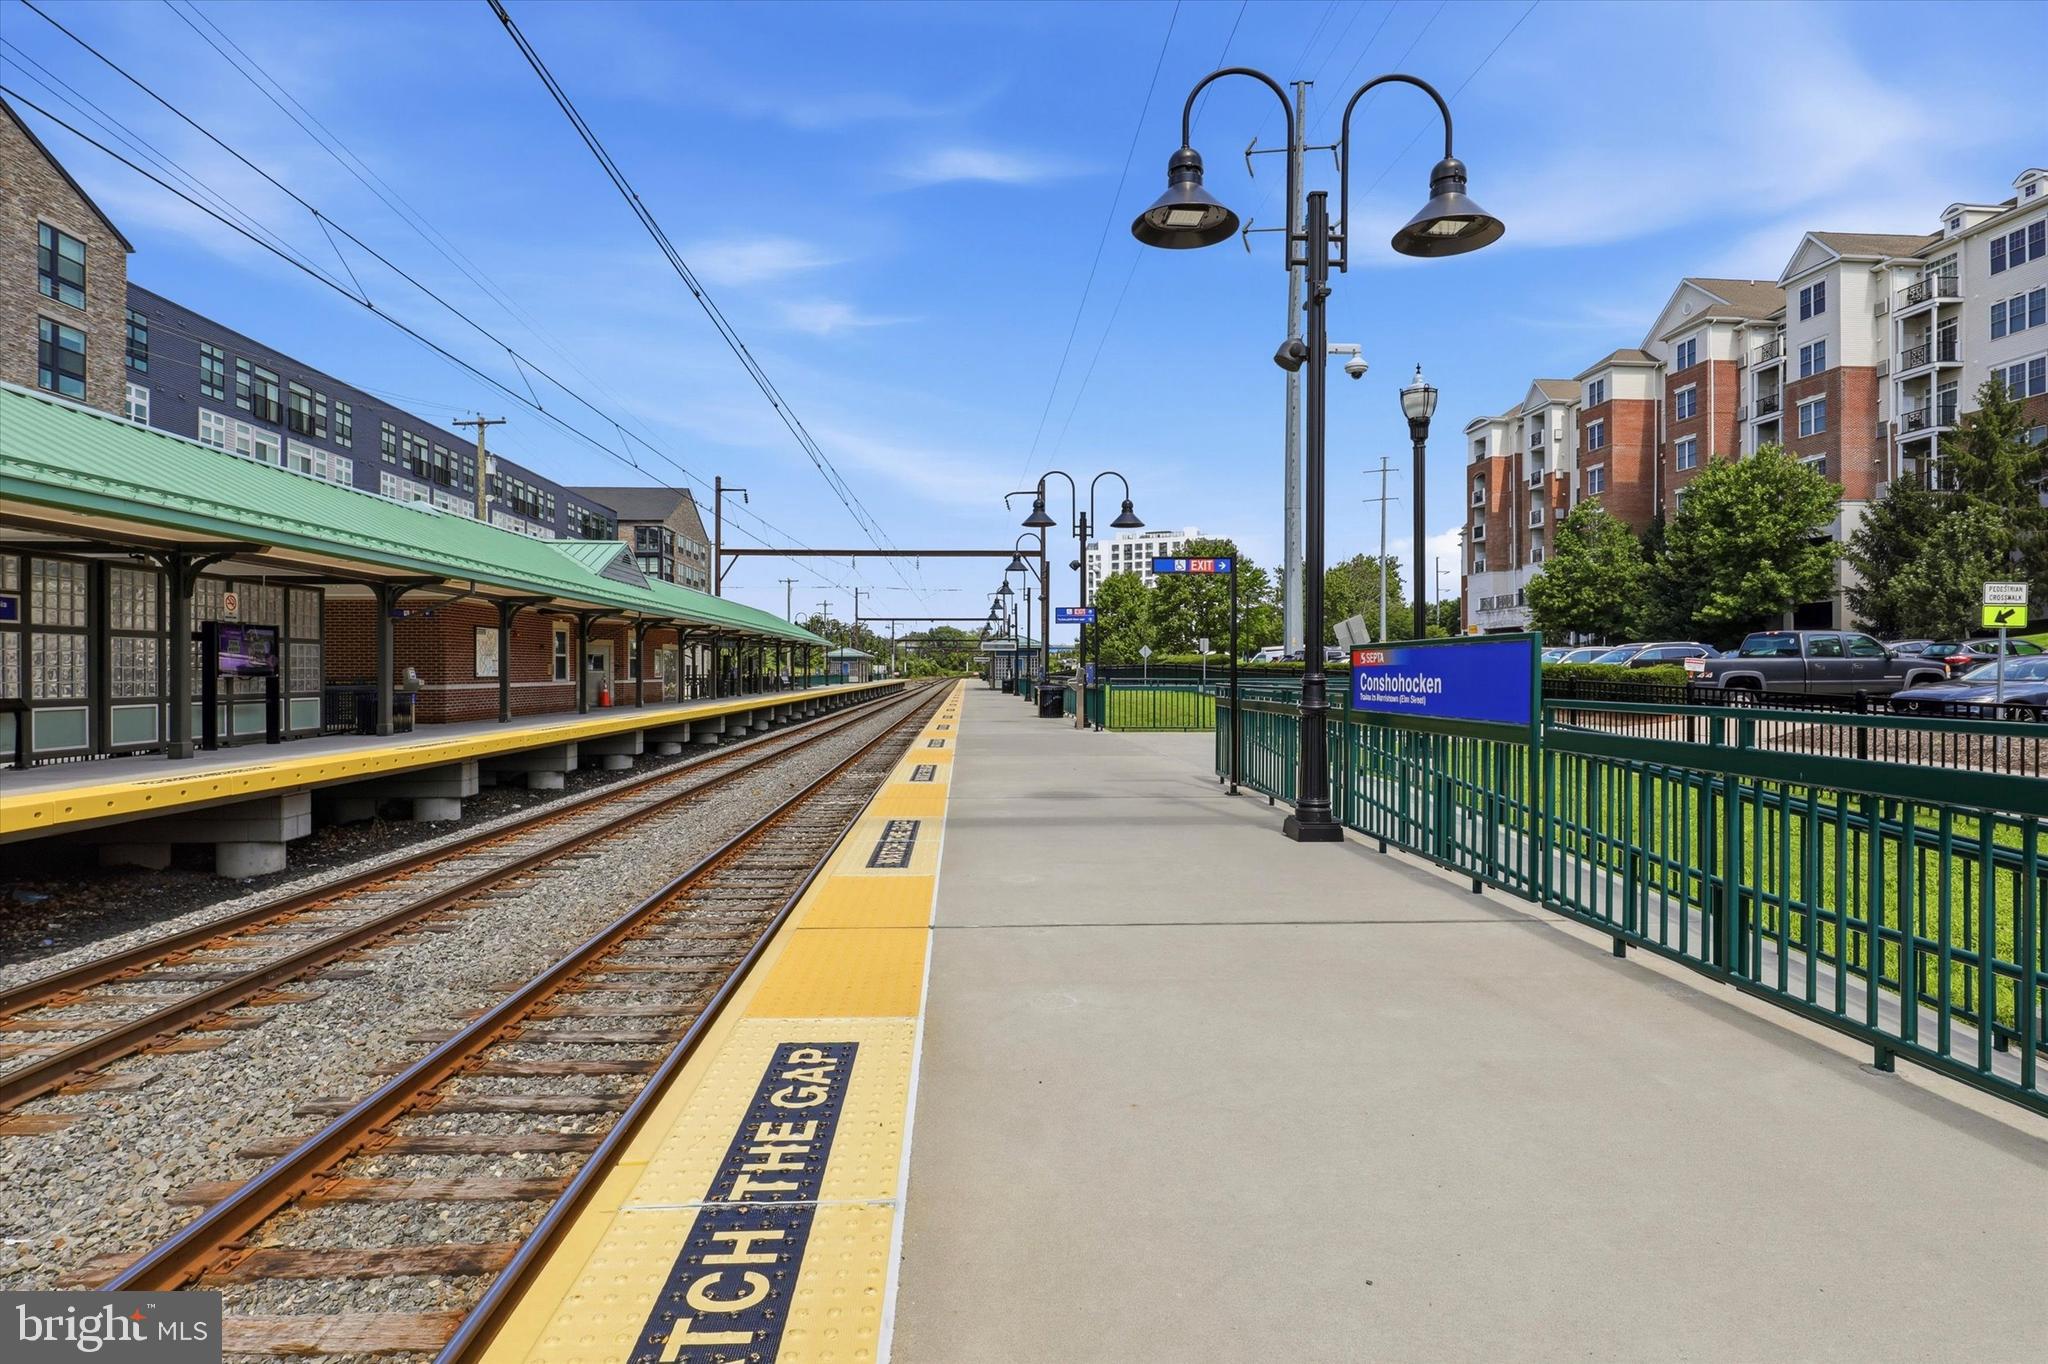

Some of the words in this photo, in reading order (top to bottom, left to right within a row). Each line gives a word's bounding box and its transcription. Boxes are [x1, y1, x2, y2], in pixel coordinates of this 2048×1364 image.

[1191, 560, 1214, 571] EXIT
[1988, 585, 2023, 593] PEDESTRIAN
[1365, 652, 1384, 664] SEPTA
[1360, 672, 1442, 694] Conshohocken
[770, 1047, 838, 1109] GAP
[728, 1119, 818, 1202] THE
[658, 1229, 786, 1364] TCH
